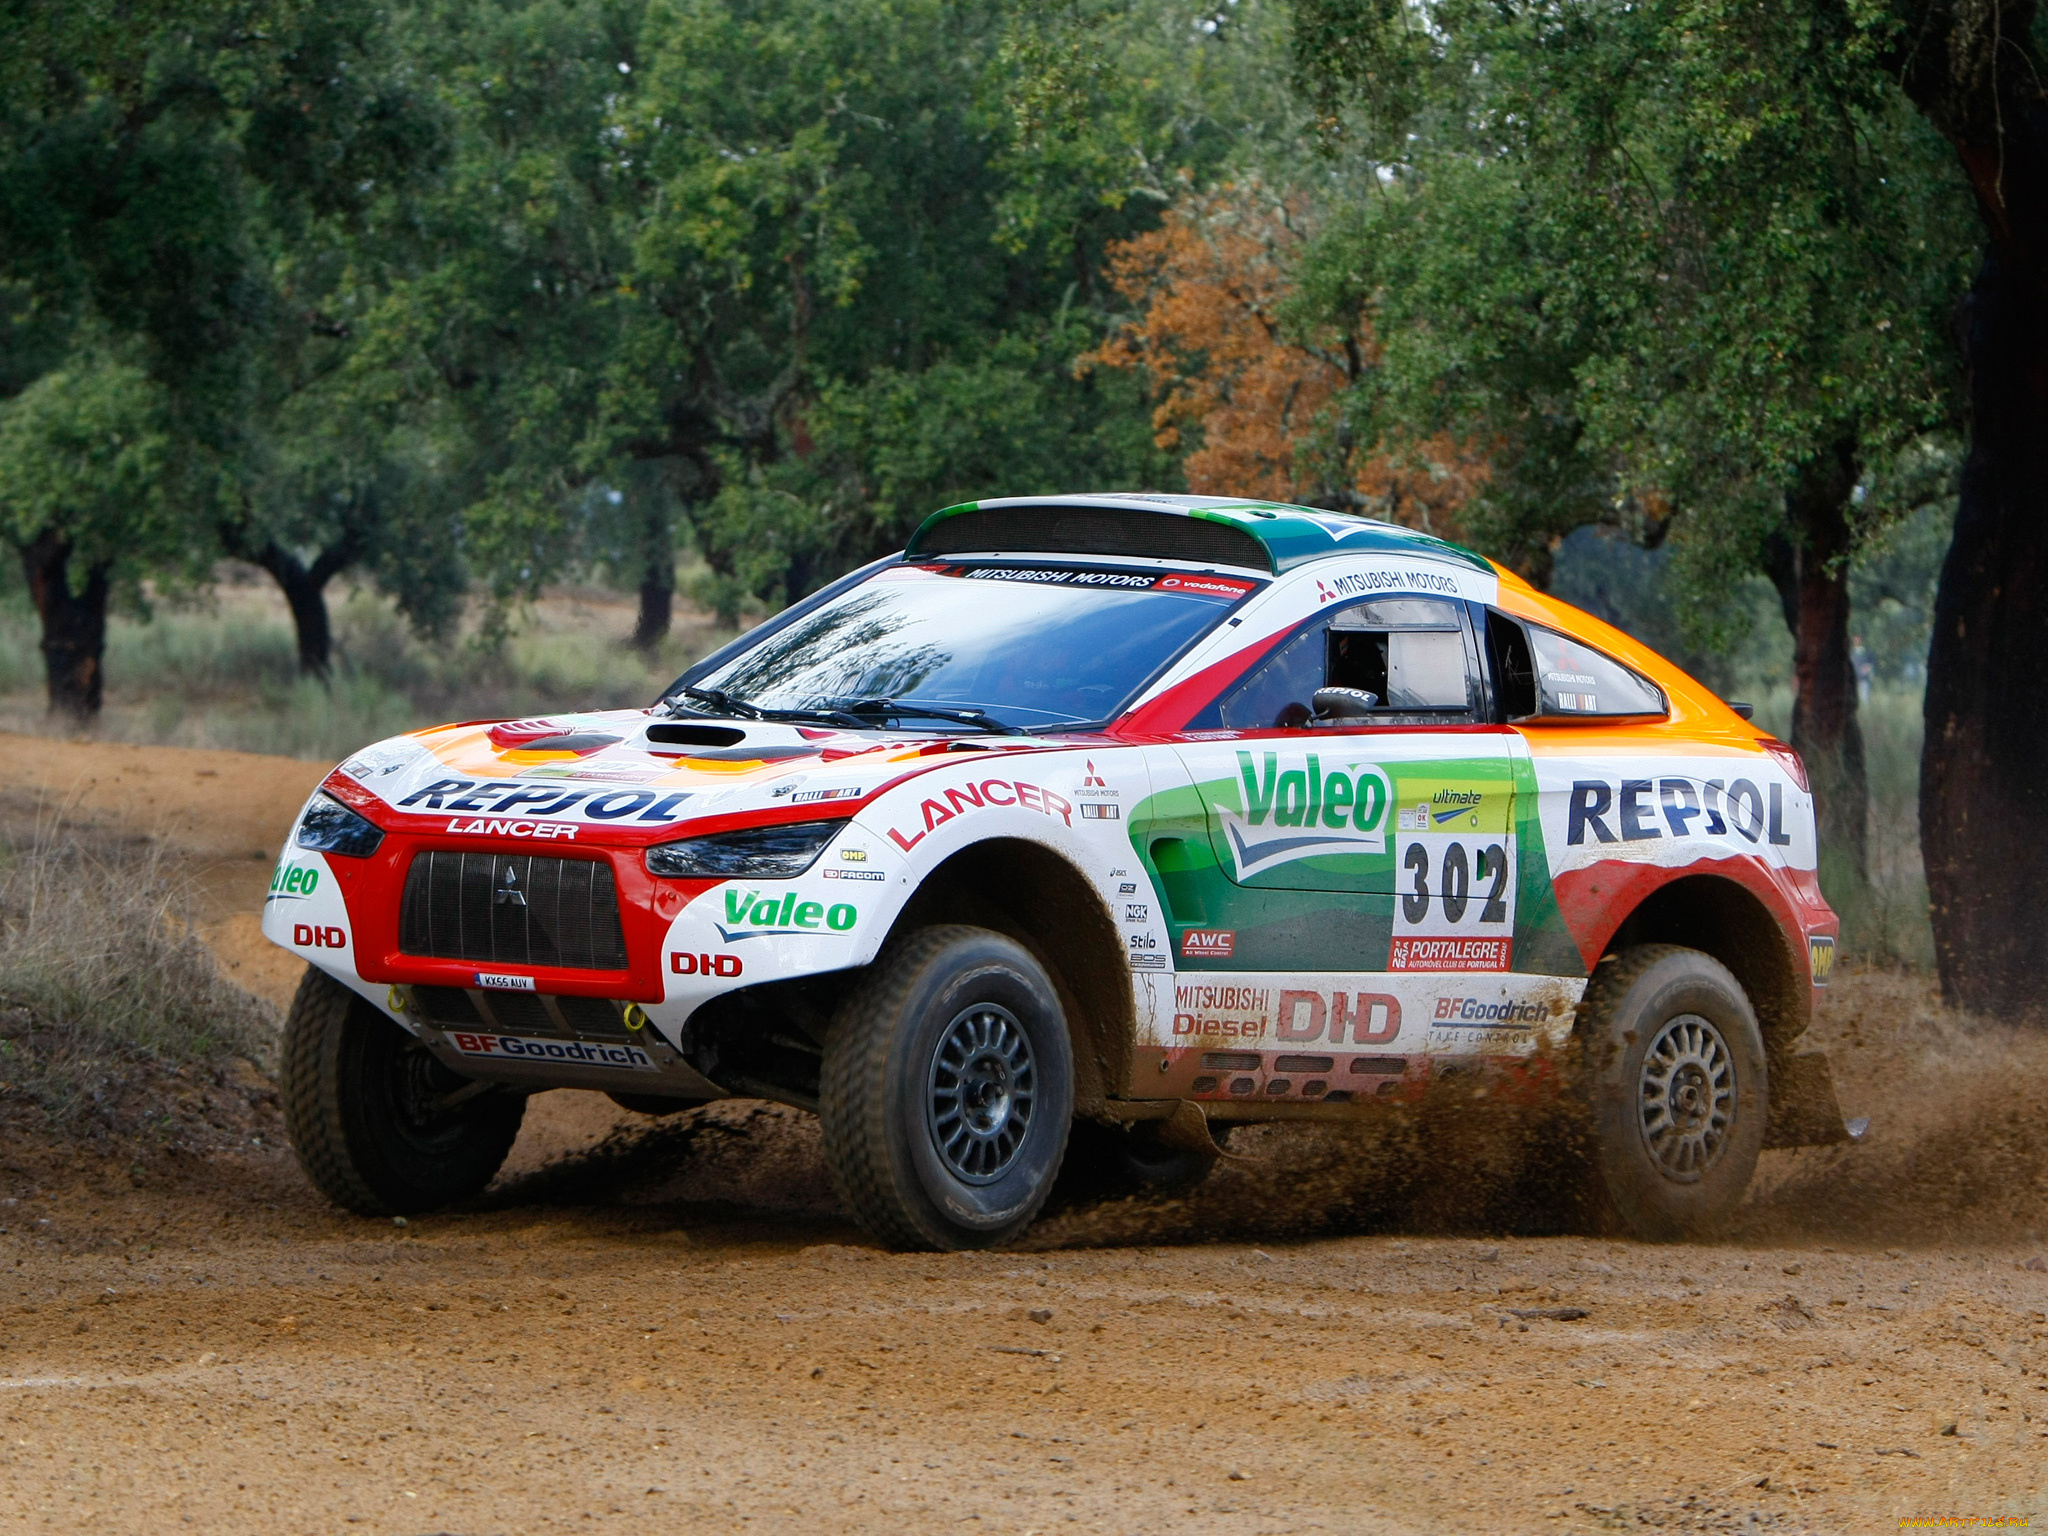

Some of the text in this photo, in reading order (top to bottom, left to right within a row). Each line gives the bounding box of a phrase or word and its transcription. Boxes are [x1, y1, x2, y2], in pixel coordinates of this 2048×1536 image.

[965, 568, 1156, 587] MITSUBISHI MOTORS
[1183, 580, 1246, 595] vodafone
[1333, 571, 1458, 596] MITSUBISHI MOTORS
[397, 778, 695, 822] REPSOL
[794, 787, 858, 802] RALLI ART
[1235, 750, 1386, 832] Valeo
[1432, 788, 1482, 805] ultimate
[886, 779, 1072, 853] LANCER
[1566, 777, 1792, 847] REPSOL
[445, 818, 579, 840] LANCER
[841, 870, 885, 880] FACOM
[1402, 842, 1509, 925] 302
[724, 889, 858, 931] Valeo
[1126, 905, 1147, 918] NGK
[1129, 932, 1156, 949] Stilo
[1186, 932, 1231, 947] AWC
[1410, 940, 1499, 959] PORTALEGRE
[1408, 959, 1498, 969] AUTOMÓVEL CLUB DE PORTUGAL
[510, 977, 528, 989] AUV
[1175, 985, 1270, 1011] MITSUBISHI
[1434, 997, 1549, 1022] BFGoodrich
[1172, 1013, 1268, 1038] Diesel
[1428, 1030, 1528, 1044] TAKE CONTROL
[454, 1033, 649, 1066] BFGoodrich
